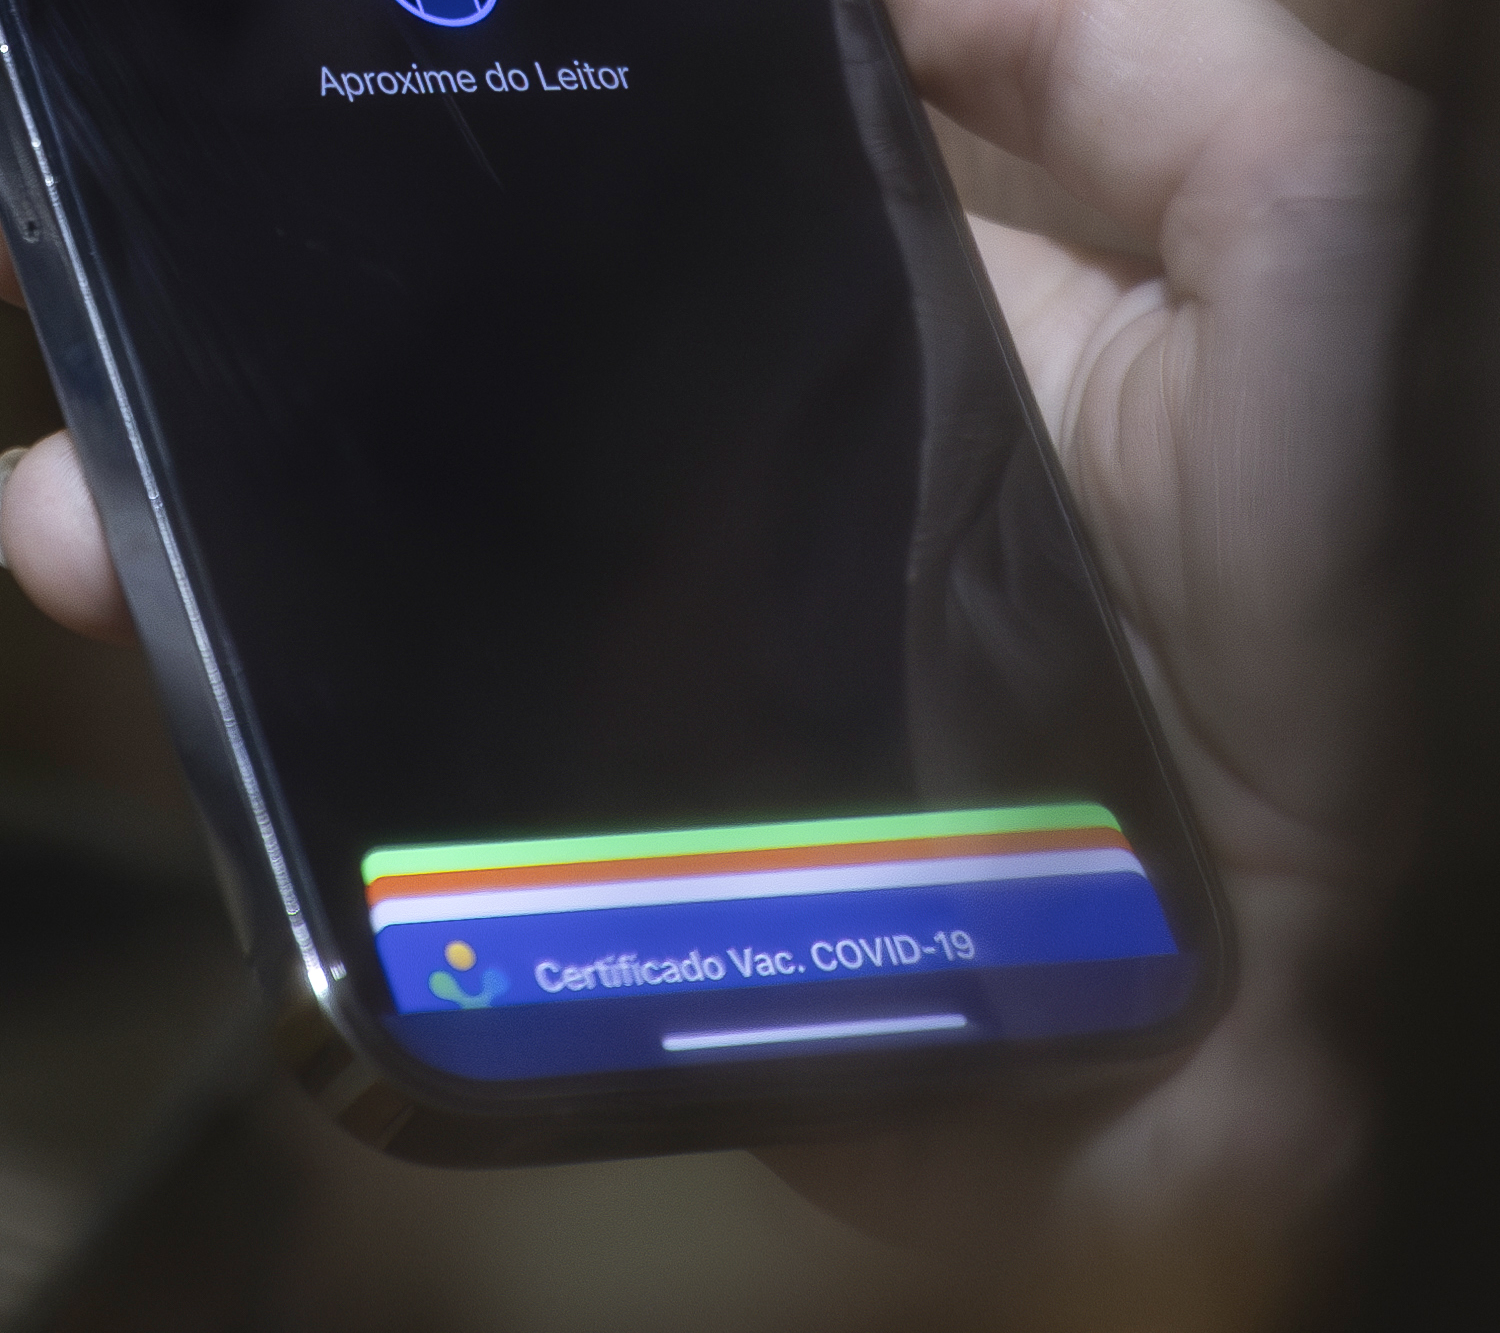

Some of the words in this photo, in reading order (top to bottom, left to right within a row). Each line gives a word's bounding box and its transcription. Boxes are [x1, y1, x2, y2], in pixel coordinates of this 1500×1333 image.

[319, 62, 479, 104] Aproxime
[484, 60, 531, 94] do
[534, 58, 630, 92] Leitor
[533, 948, 726, 994] Certificado
[725, 945, 807, 979] Vac.
[808, 928, 976, 973] COVID-19
